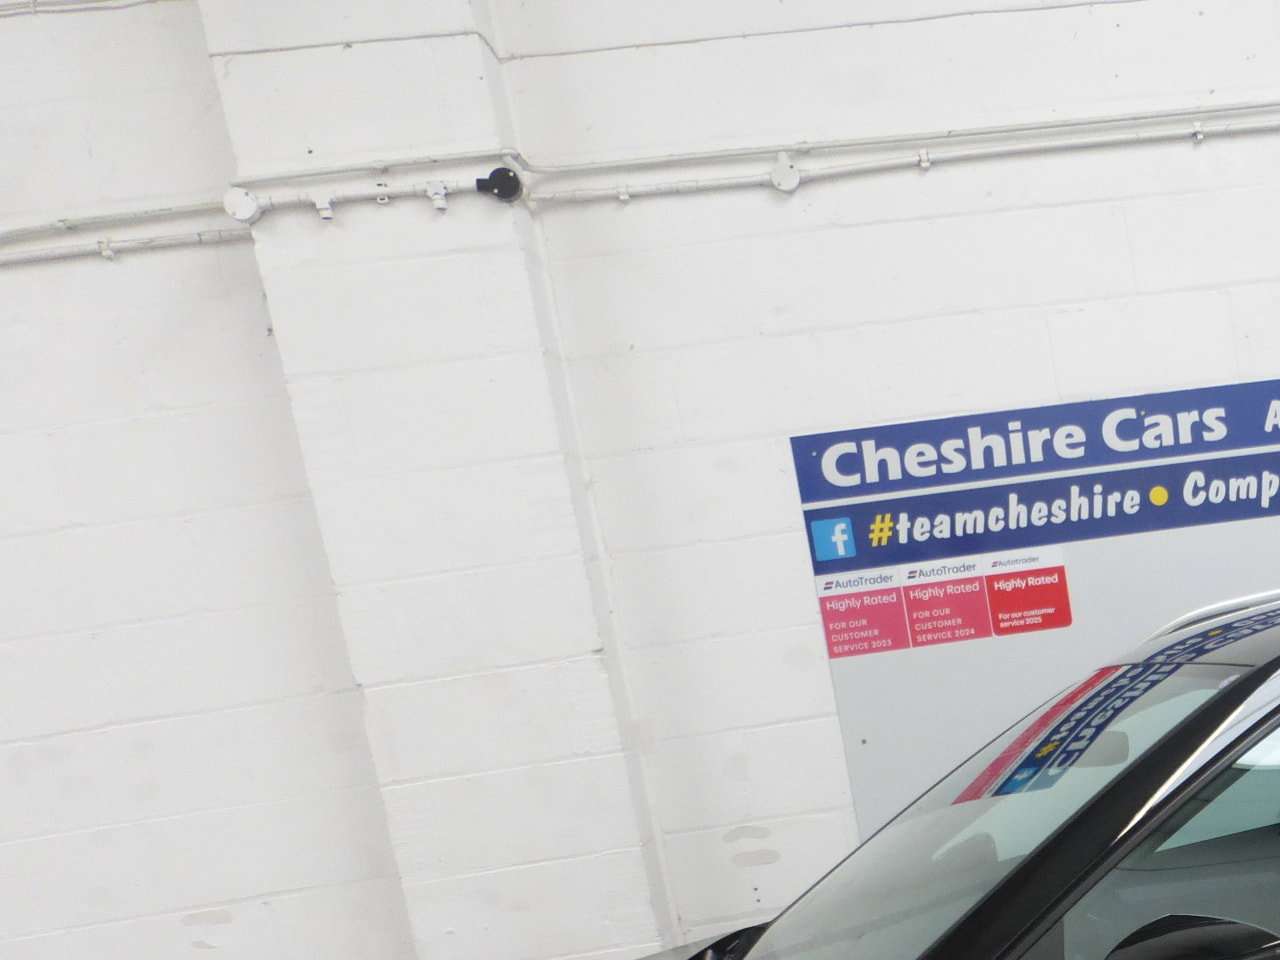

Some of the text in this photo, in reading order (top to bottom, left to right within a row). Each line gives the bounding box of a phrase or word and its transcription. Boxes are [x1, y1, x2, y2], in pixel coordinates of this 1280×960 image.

[821, 407, 1229, 488] Cheshire Cars
[868, 483, 1141, 548] #teamcheshire
[918, 562, 977, 579] AutoTrader
[834, 574, 894, 589] AutoTrader
[994, 573, 1059, 592] Highly Rated
[910, 581, 980, 601] Highly Rated
[826, 592, 897, 612] Highly Rated
[913, 607, 951, 620] FOR OUR
[829, 618, 868, 631] FOR OUR
[914, 618, 963, 632] CUSTOMER
[831, 629, 880, 642] CUSTOMER
[916, 631, 953, 643] SERVICE
[833, 641, 870, 653] SERVICE
